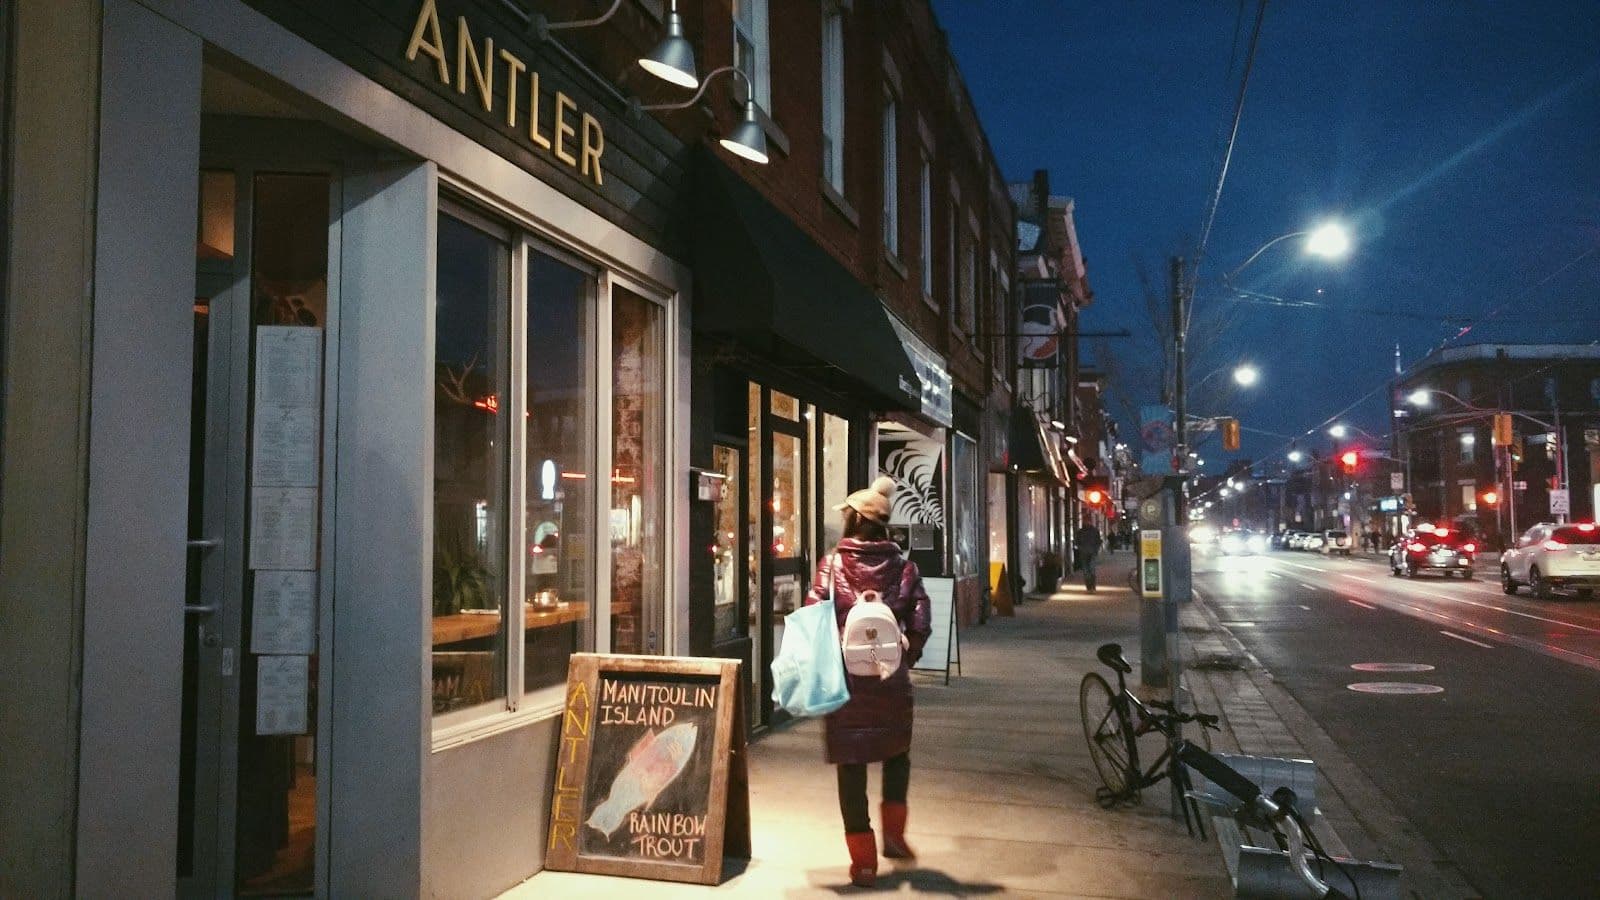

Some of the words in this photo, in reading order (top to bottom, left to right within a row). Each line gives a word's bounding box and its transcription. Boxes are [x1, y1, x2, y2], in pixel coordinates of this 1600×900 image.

[406, 0, 604, 185] ANTLER
[603, 679, 715, 708] MANITOULIN
[601, 705, 675, 726] ISLAND
[551, 681, 589, 850] ANTLER
[630, 812, 708, 836] RAINBOW
[632, 835, 701, 858] TROUT
